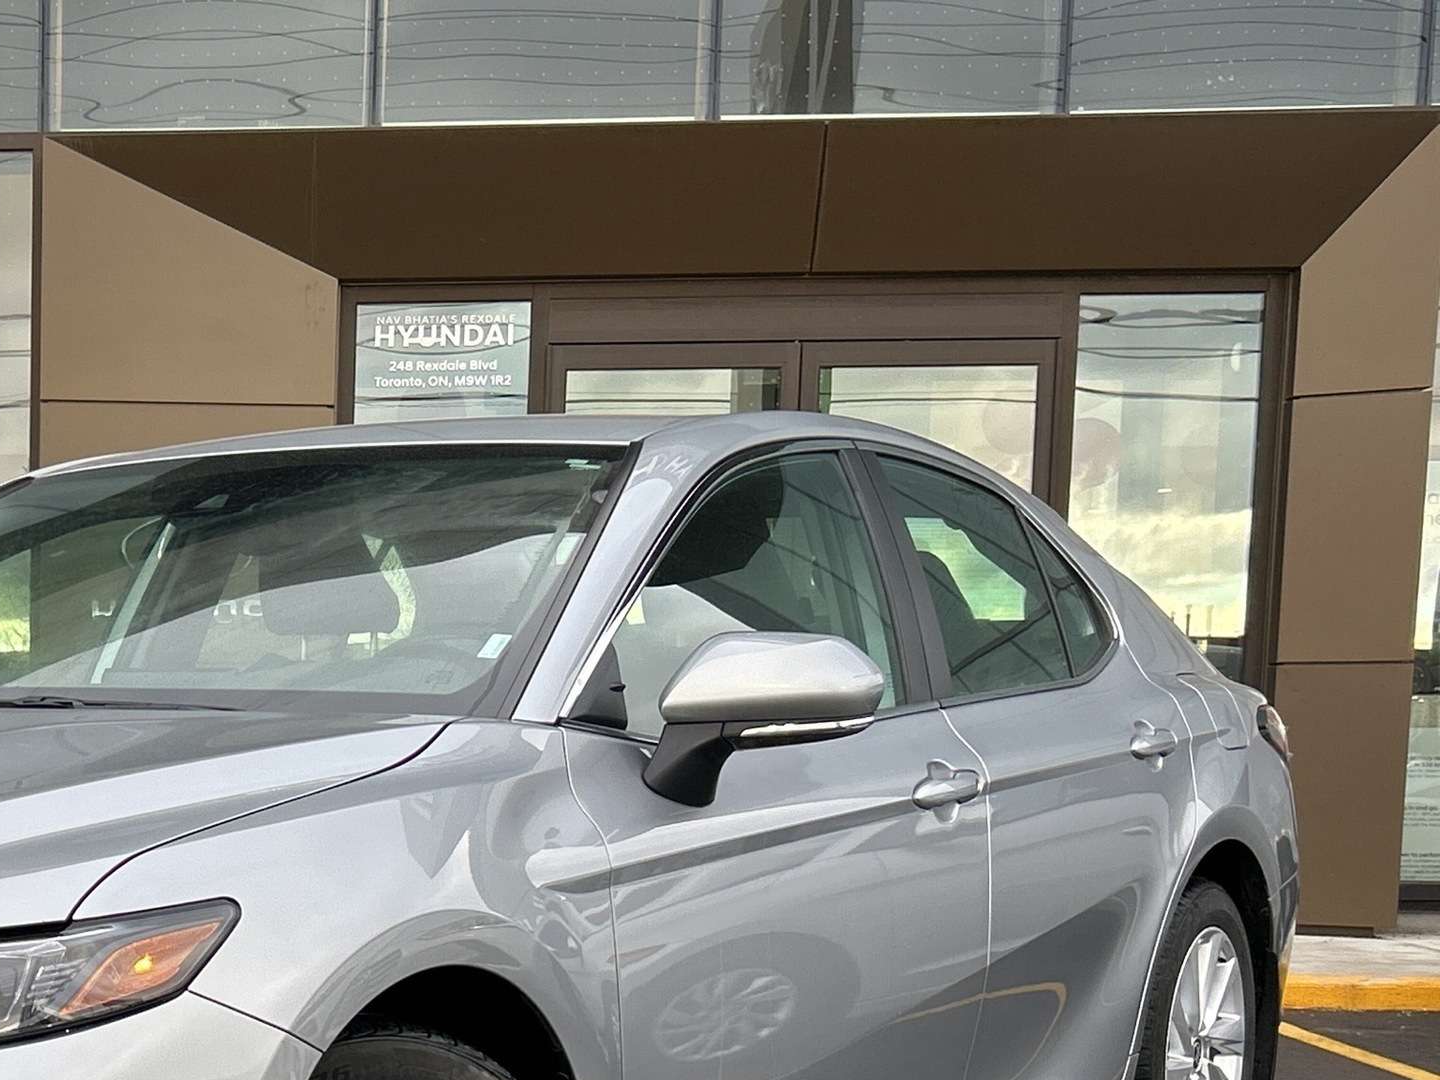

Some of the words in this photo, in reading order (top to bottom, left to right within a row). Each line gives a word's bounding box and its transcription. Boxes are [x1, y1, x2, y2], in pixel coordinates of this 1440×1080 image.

[376, 316, 401, 325] NAV
[404, 315, 458, 325] BHATIA'S
[461, 314, 516, 324] REXDALE
[373, 323, 515, 348] HYUNDAI
[389, 360, 413, 372] 248
[416, 359, 467, 371] Rexdale
[469, 359, 498, 371] Blvd
[374, 377, 427, 389] Toronto,
[428, 376, 452, 388] ON,
[454, 375, 488, 387] M9W
[489, 374, 512, 386] 1R2
